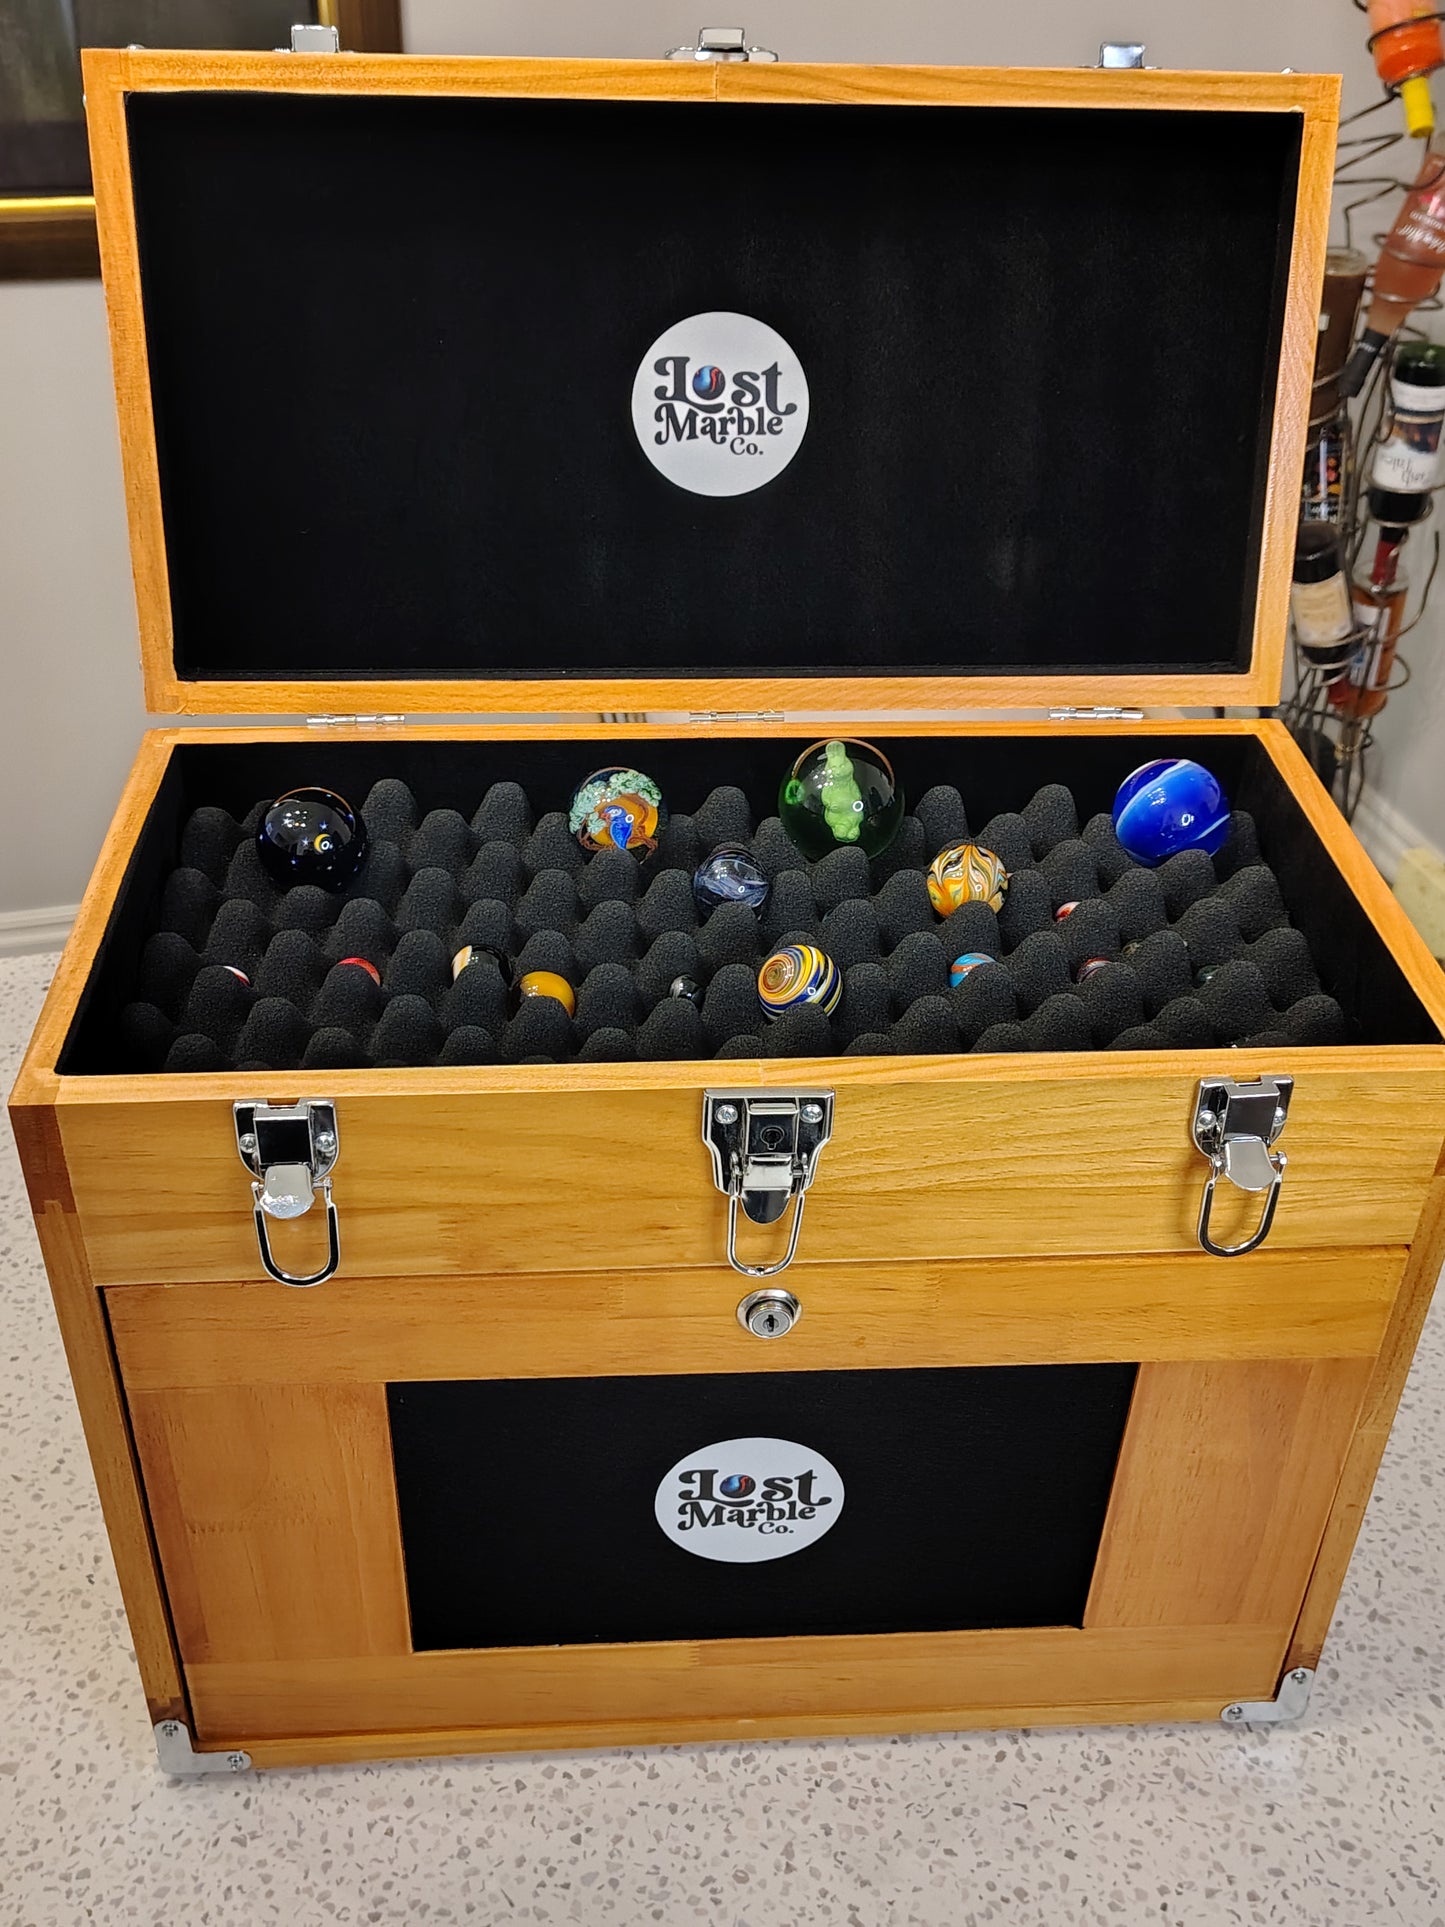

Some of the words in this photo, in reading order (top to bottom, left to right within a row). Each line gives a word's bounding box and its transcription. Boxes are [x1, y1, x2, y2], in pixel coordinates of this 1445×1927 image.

[654, 356, 797, 415] Lost
[654, 403, 783, 445] Marble
[730, 437, 763, 455] Co.
[678, 1469, 832, 1507] Lost
[677, 1501, 816, 1531] Marble
[758, 1522, 794, 1534] Co.
